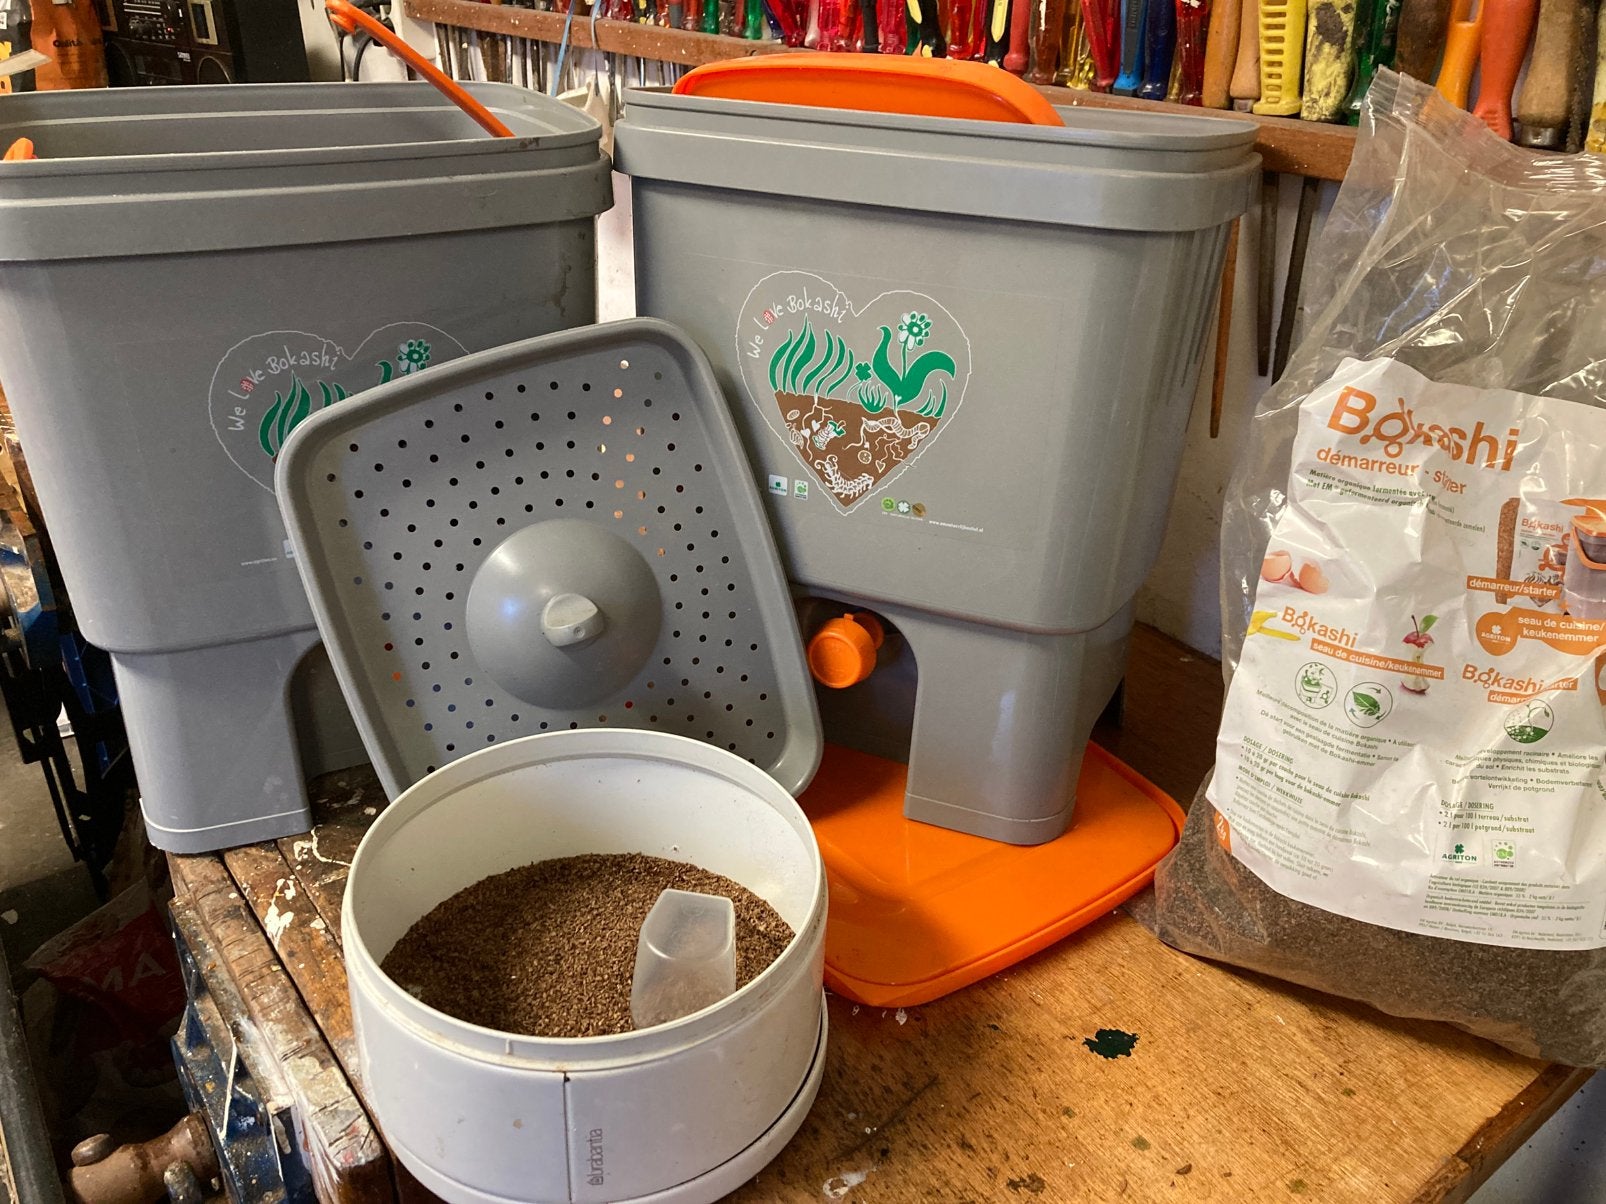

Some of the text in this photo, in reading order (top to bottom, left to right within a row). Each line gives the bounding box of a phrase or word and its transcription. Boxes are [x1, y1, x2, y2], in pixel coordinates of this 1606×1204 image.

[746, 286, 850, 359] We Love Bokashi
[228, 344, 342, 431] We Love Bokashi
[1327, 385, 1520, 472] Bokashi
[1316, 447, 1420, 476] démarreur
[1337, 477, 1371, 491] organique
[1470, 579, 1557, 597] démarreur/starter
[1282, 606, 1359, 649] Bokashi
[1518, 616, 1605, 632] seau de cuisine/
[1523, 627, 1600, 643] keukenemmer
[1313, 642, 1442, 679] seau de cuisine/keukenemmer
[1462, 663, 1544, 693] Bokashi
[1243, 735, 1263, 751] DOSAGE
[1268, 748, 1294, 764] DOSERING
[1538, 767, 1570, 775] substrats
[1523, 785, 1555, 793] potgrond
[1441, 800, 1463, 809] DOSAGE
[1467, 802, 1494, 810] DOSERING
[1461, 822, 1470, 830] 100
[1441, 853, 1477, 861] AGRITON
[586, 1128, 604, 1177] brabantia
